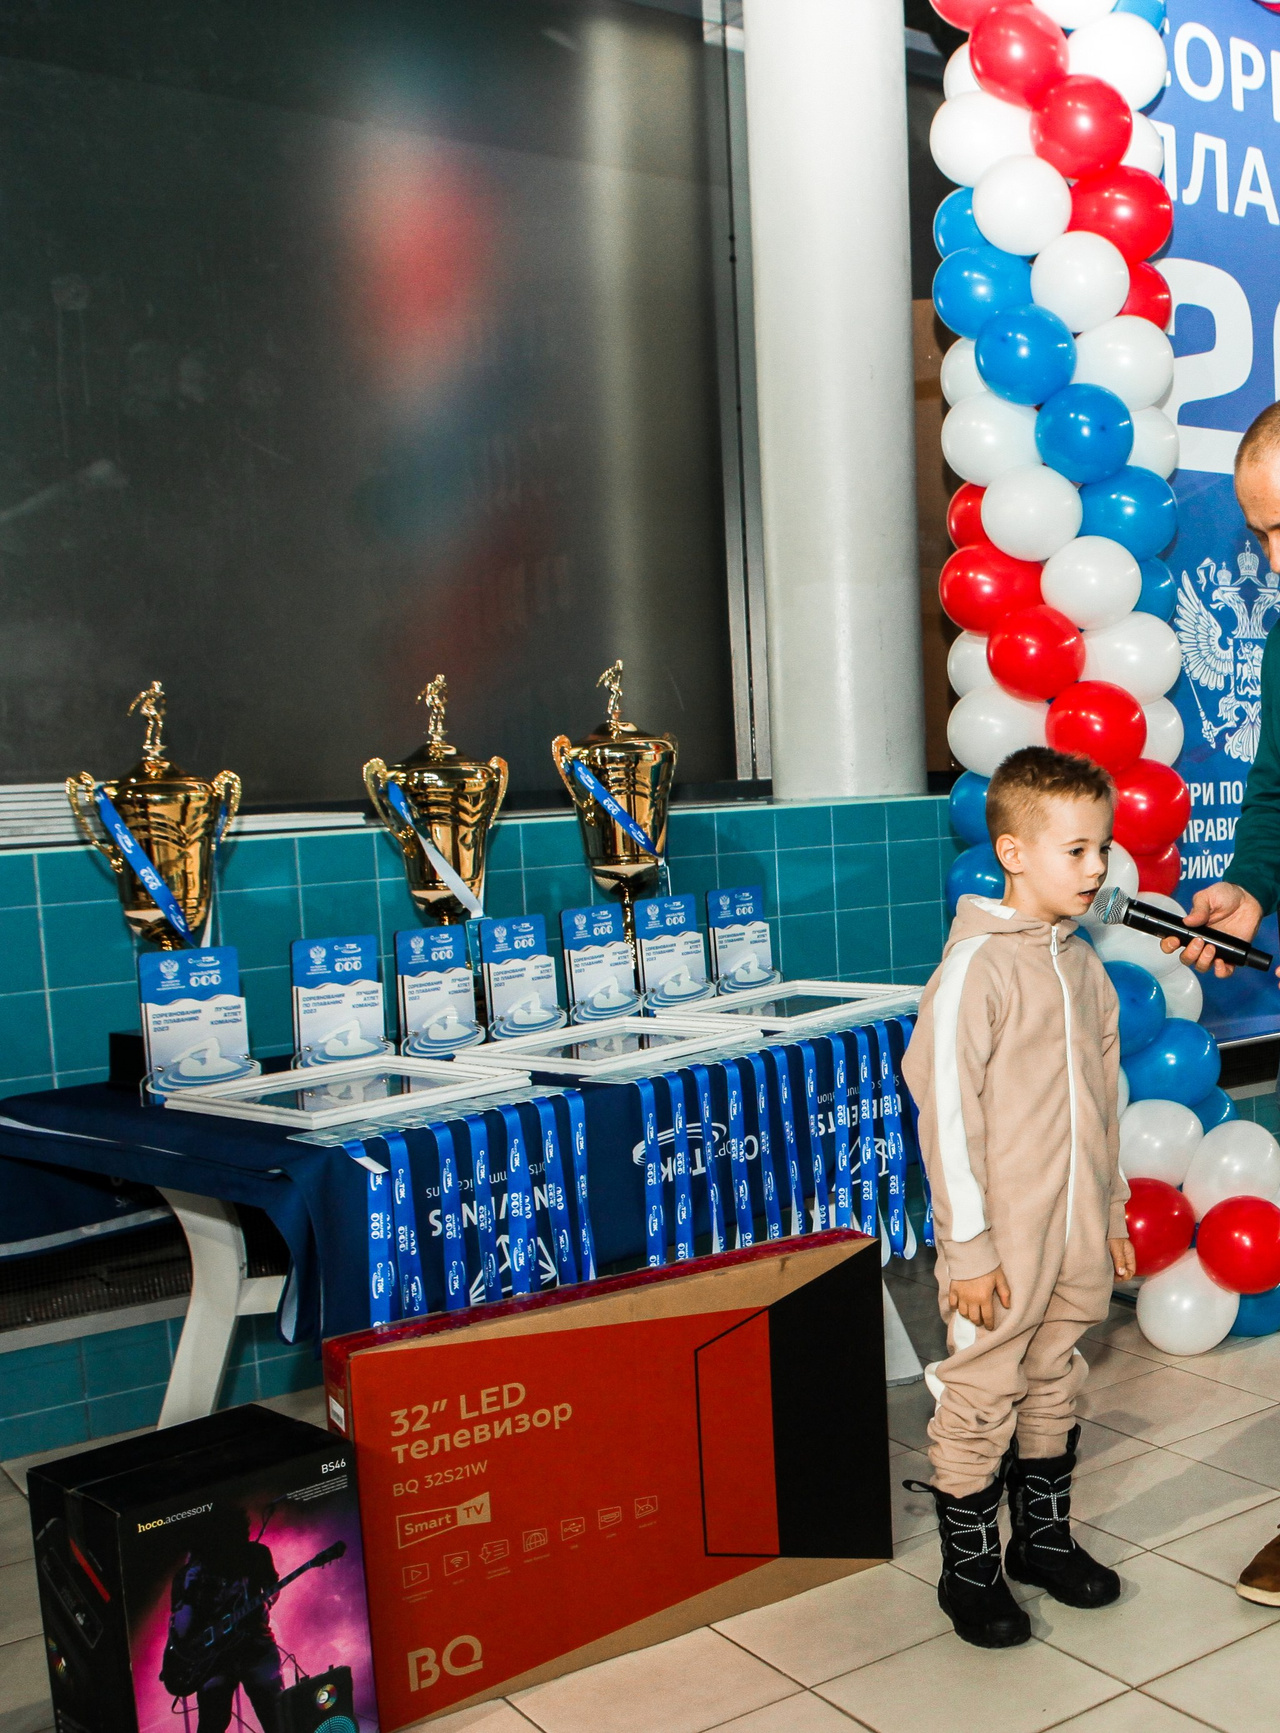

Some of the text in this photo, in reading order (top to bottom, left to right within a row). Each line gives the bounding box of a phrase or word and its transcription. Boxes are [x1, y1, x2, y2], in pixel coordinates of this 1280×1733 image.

[1186, 781, 1248, 807] РИ ПО
[459, 1382, 526, 1420] LED
[391, 1402, 573, 1464] телевизор
[321, 1458, 347, 1475] BS46
[392, 1460, 489, 1498] BQ 32S21W
[137, 1502, 214, 1533] hoco.accessory
[404, 1502, 485, 1537] Smart TV
[407, 1634, 484, 1693] BQ
